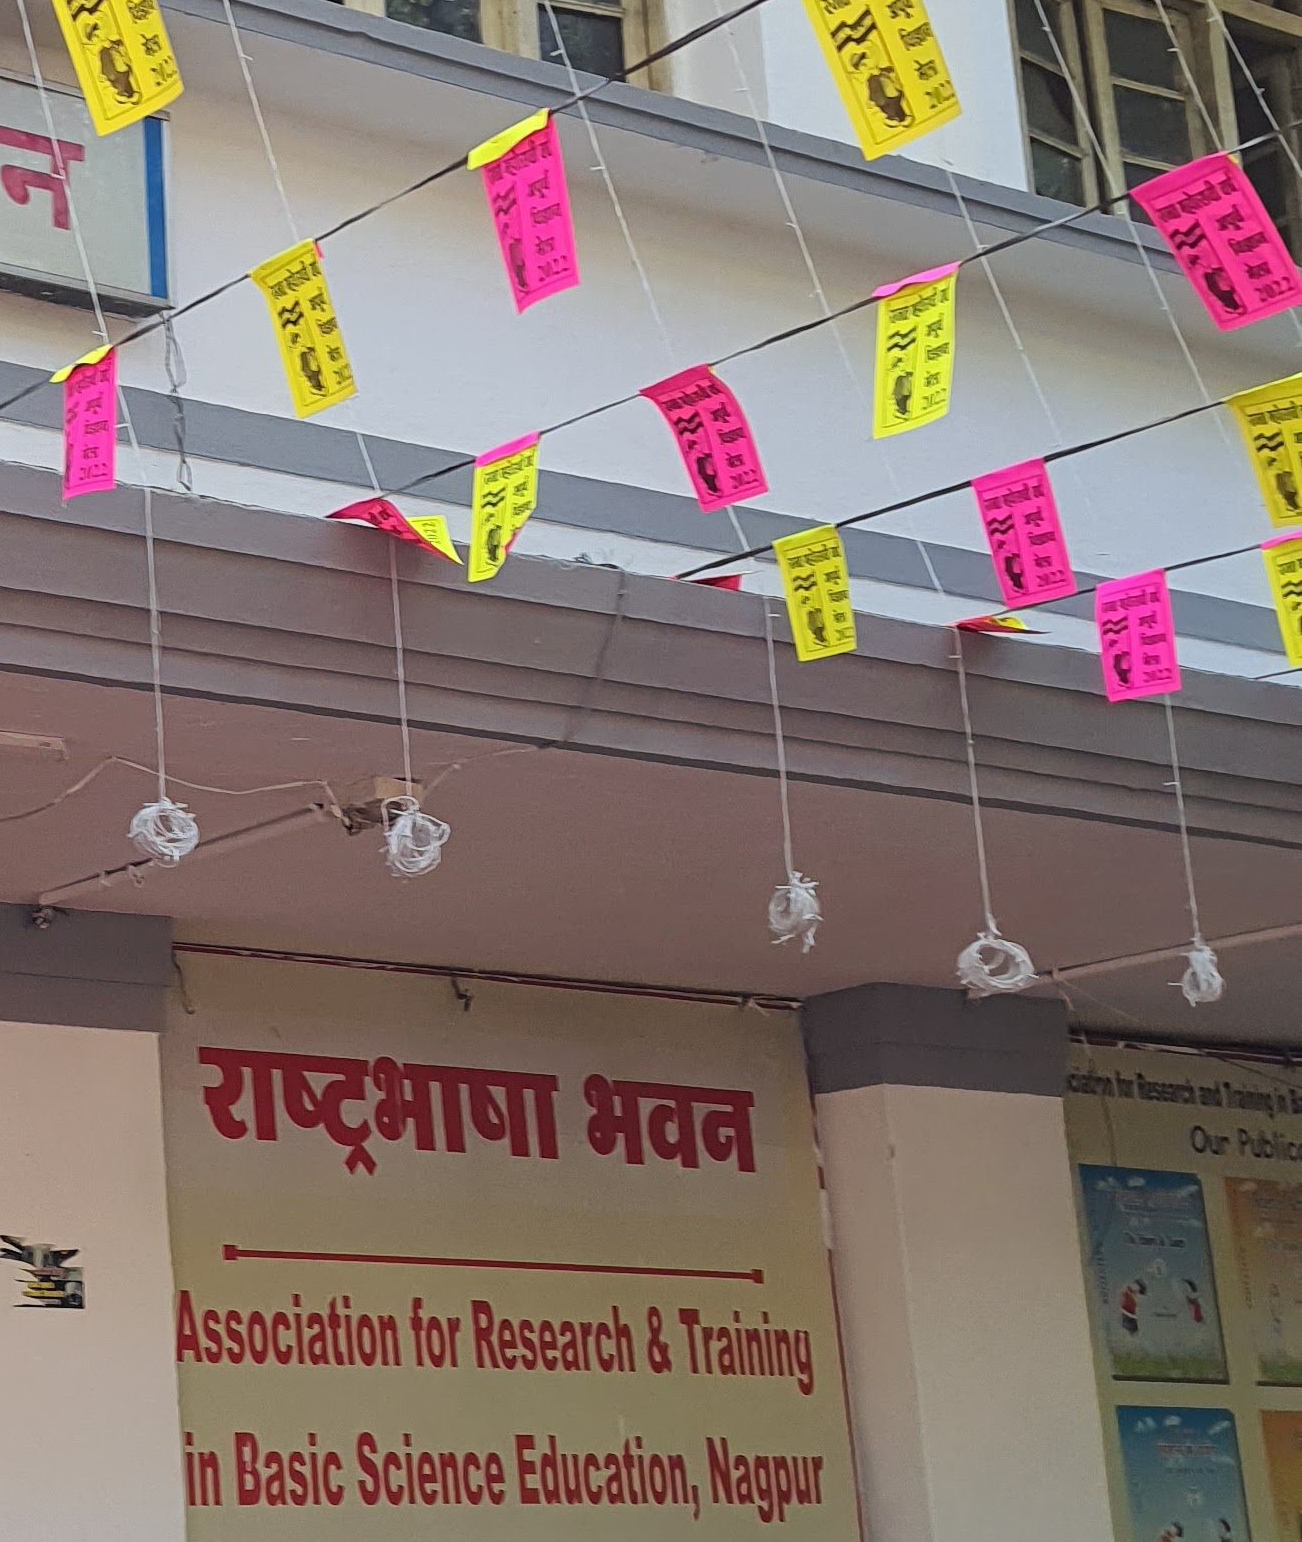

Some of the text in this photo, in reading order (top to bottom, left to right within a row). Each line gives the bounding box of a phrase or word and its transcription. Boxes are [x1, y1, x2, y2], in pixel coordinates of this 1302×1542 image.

[1254, 276, 1294, 302] 2022
[198, 1046, 756, 1175] राष्ट्रभाषा भवन
[1136, 1073, 1196, 1104] Research
[1199, 1081, 1221, 1107] and
[1223, 1081, 1274, 1118] Training
[1191, 1125, 1229, 1156] Our
[176, 1289, 814, 1395] Association for Research & Training
[185, 1431, 824, 1524] in Basic Science Education, Nagpur
